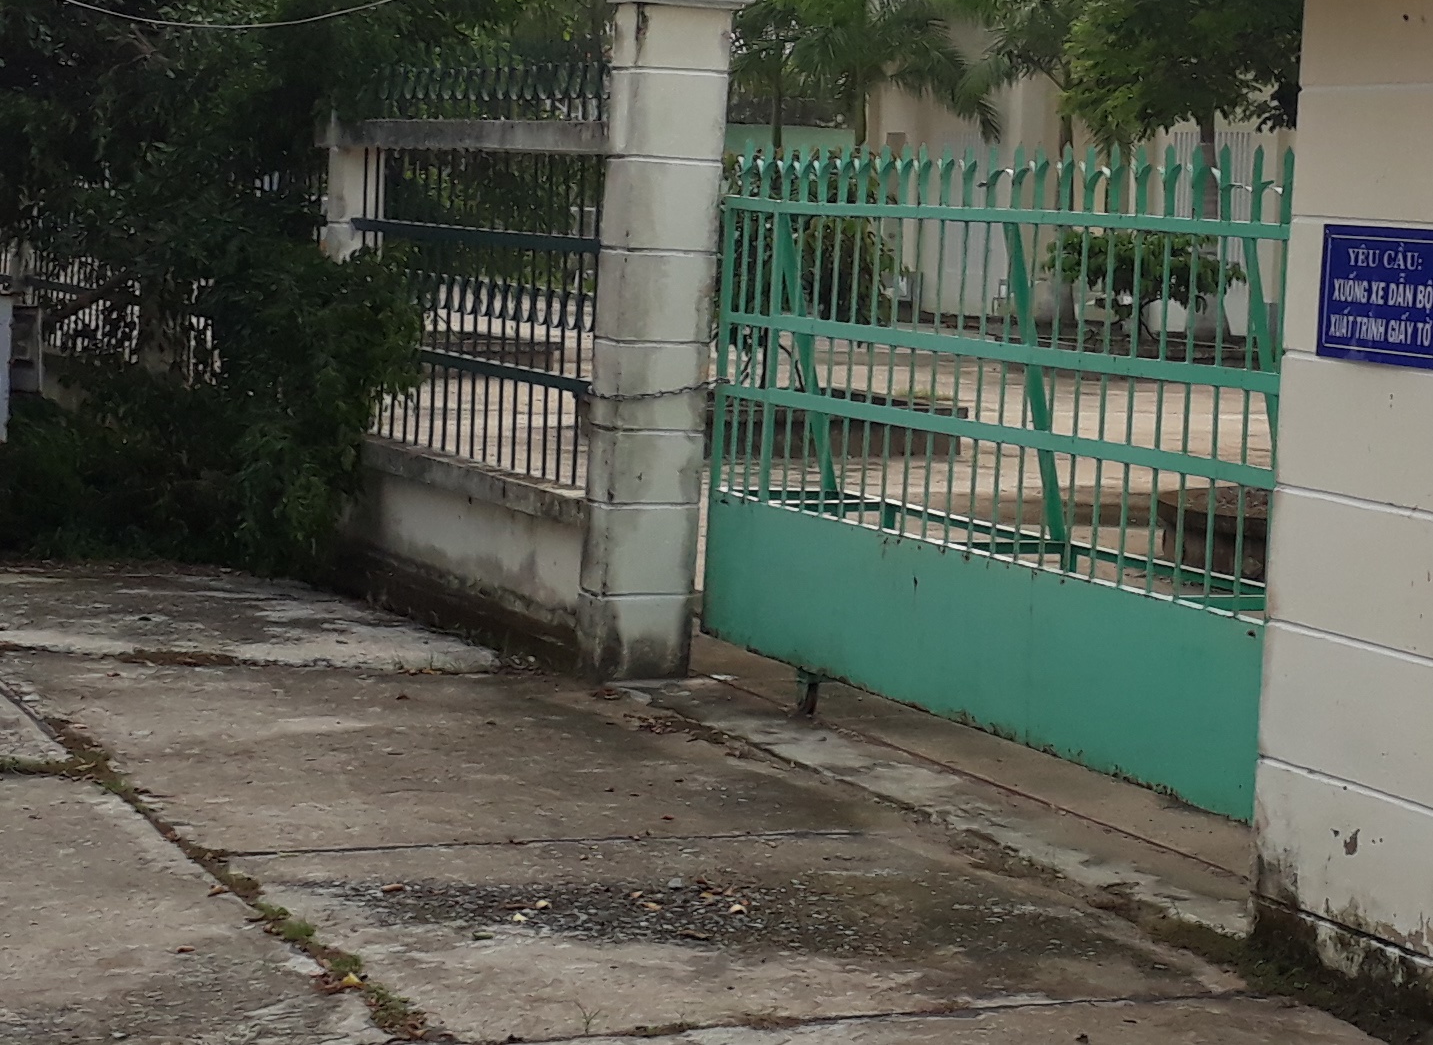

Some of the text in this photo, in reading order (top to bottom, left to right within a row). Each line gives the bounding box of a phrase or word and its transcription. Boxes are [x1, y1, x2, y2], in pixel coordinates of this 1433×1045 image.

[1348, 242, 1423, 271] YÊU CẦU:
[1332, 271, 1433, 314] XUỐNG XE DẪN BỘ
[1329, 306, 1433, 347] XUẤT TRÌNH GIẤY TỜ
